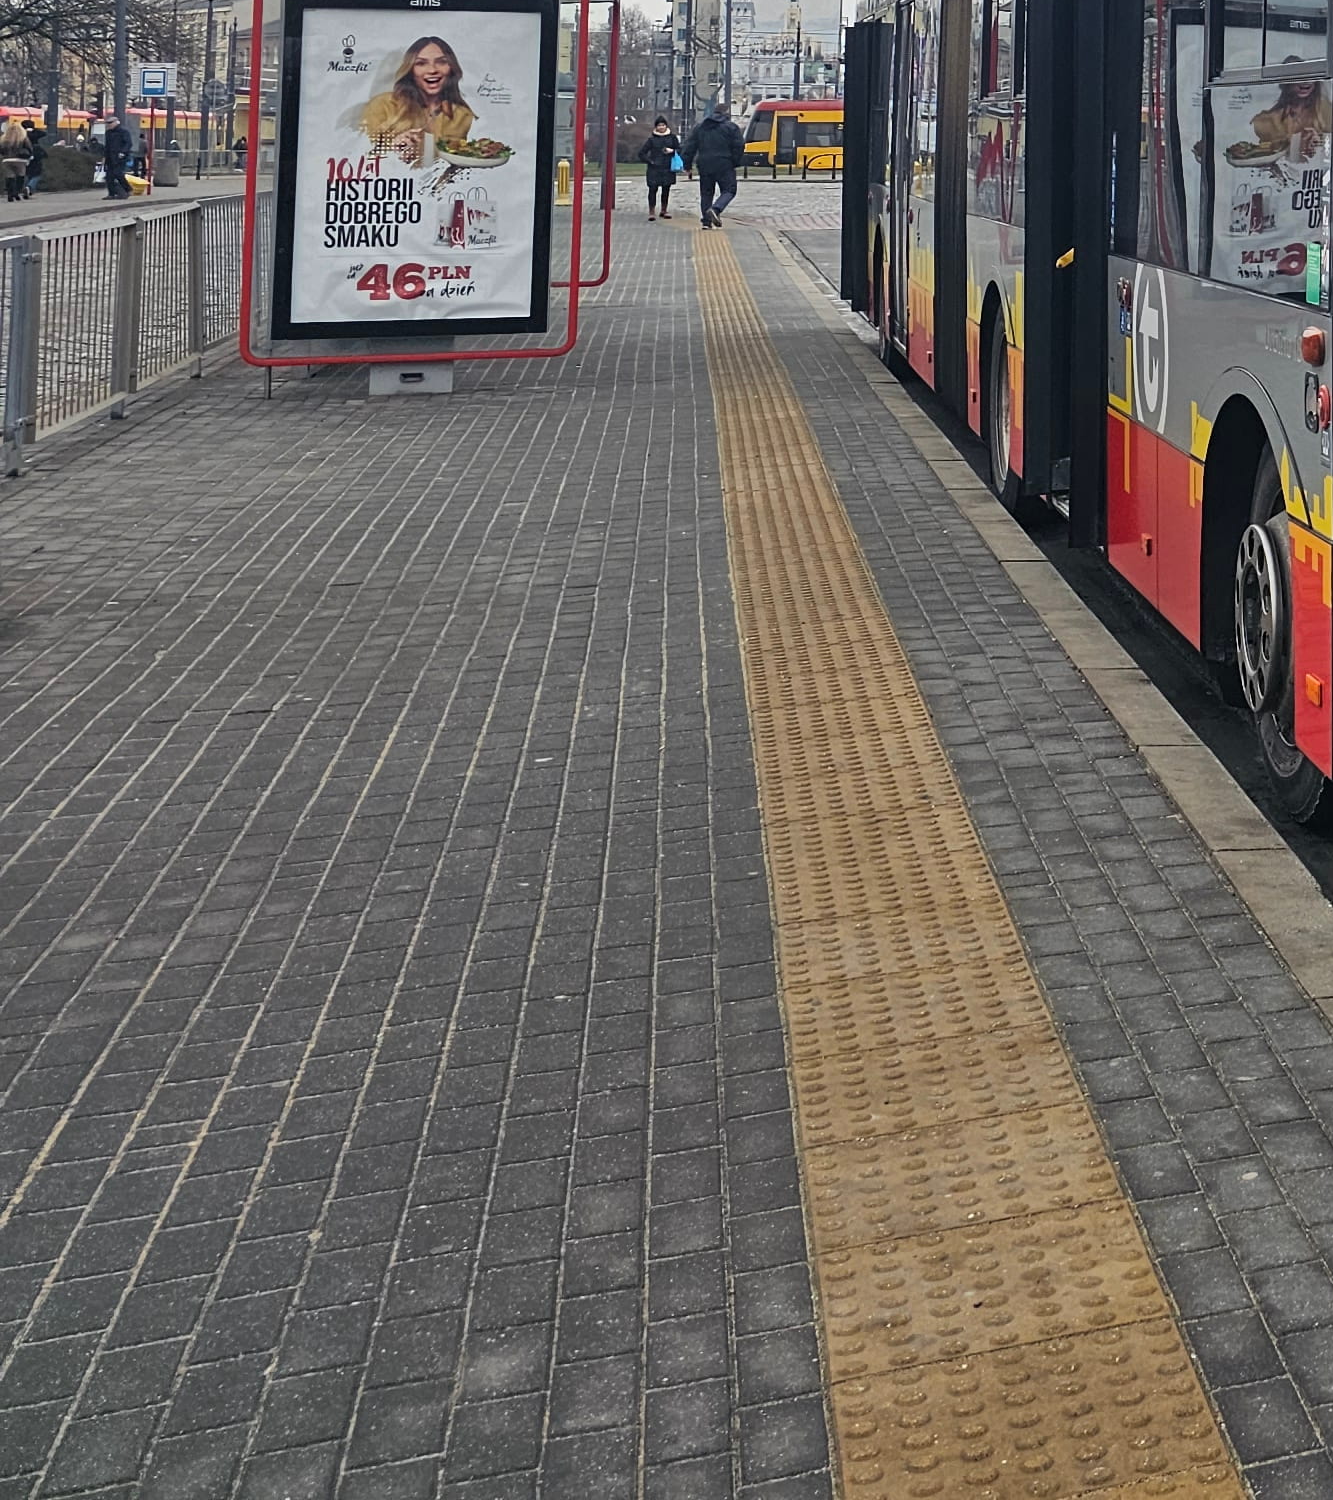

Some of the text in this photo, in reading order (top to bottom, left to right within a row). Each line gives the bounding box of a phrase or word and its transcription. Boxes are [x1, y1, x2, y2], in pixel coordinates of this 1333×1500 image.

[327, 61, 368, 74] Maczfit
[326, 157, 354, 184] 10
[326, 178, 413, 201] HISTORII
[325, 201, 422, 225] DOBREGO
[323, 225, 400, 248] SMAKU
[356, 262, 472, 300] 46 PLN
[440, 280, 475, 298] dzień
